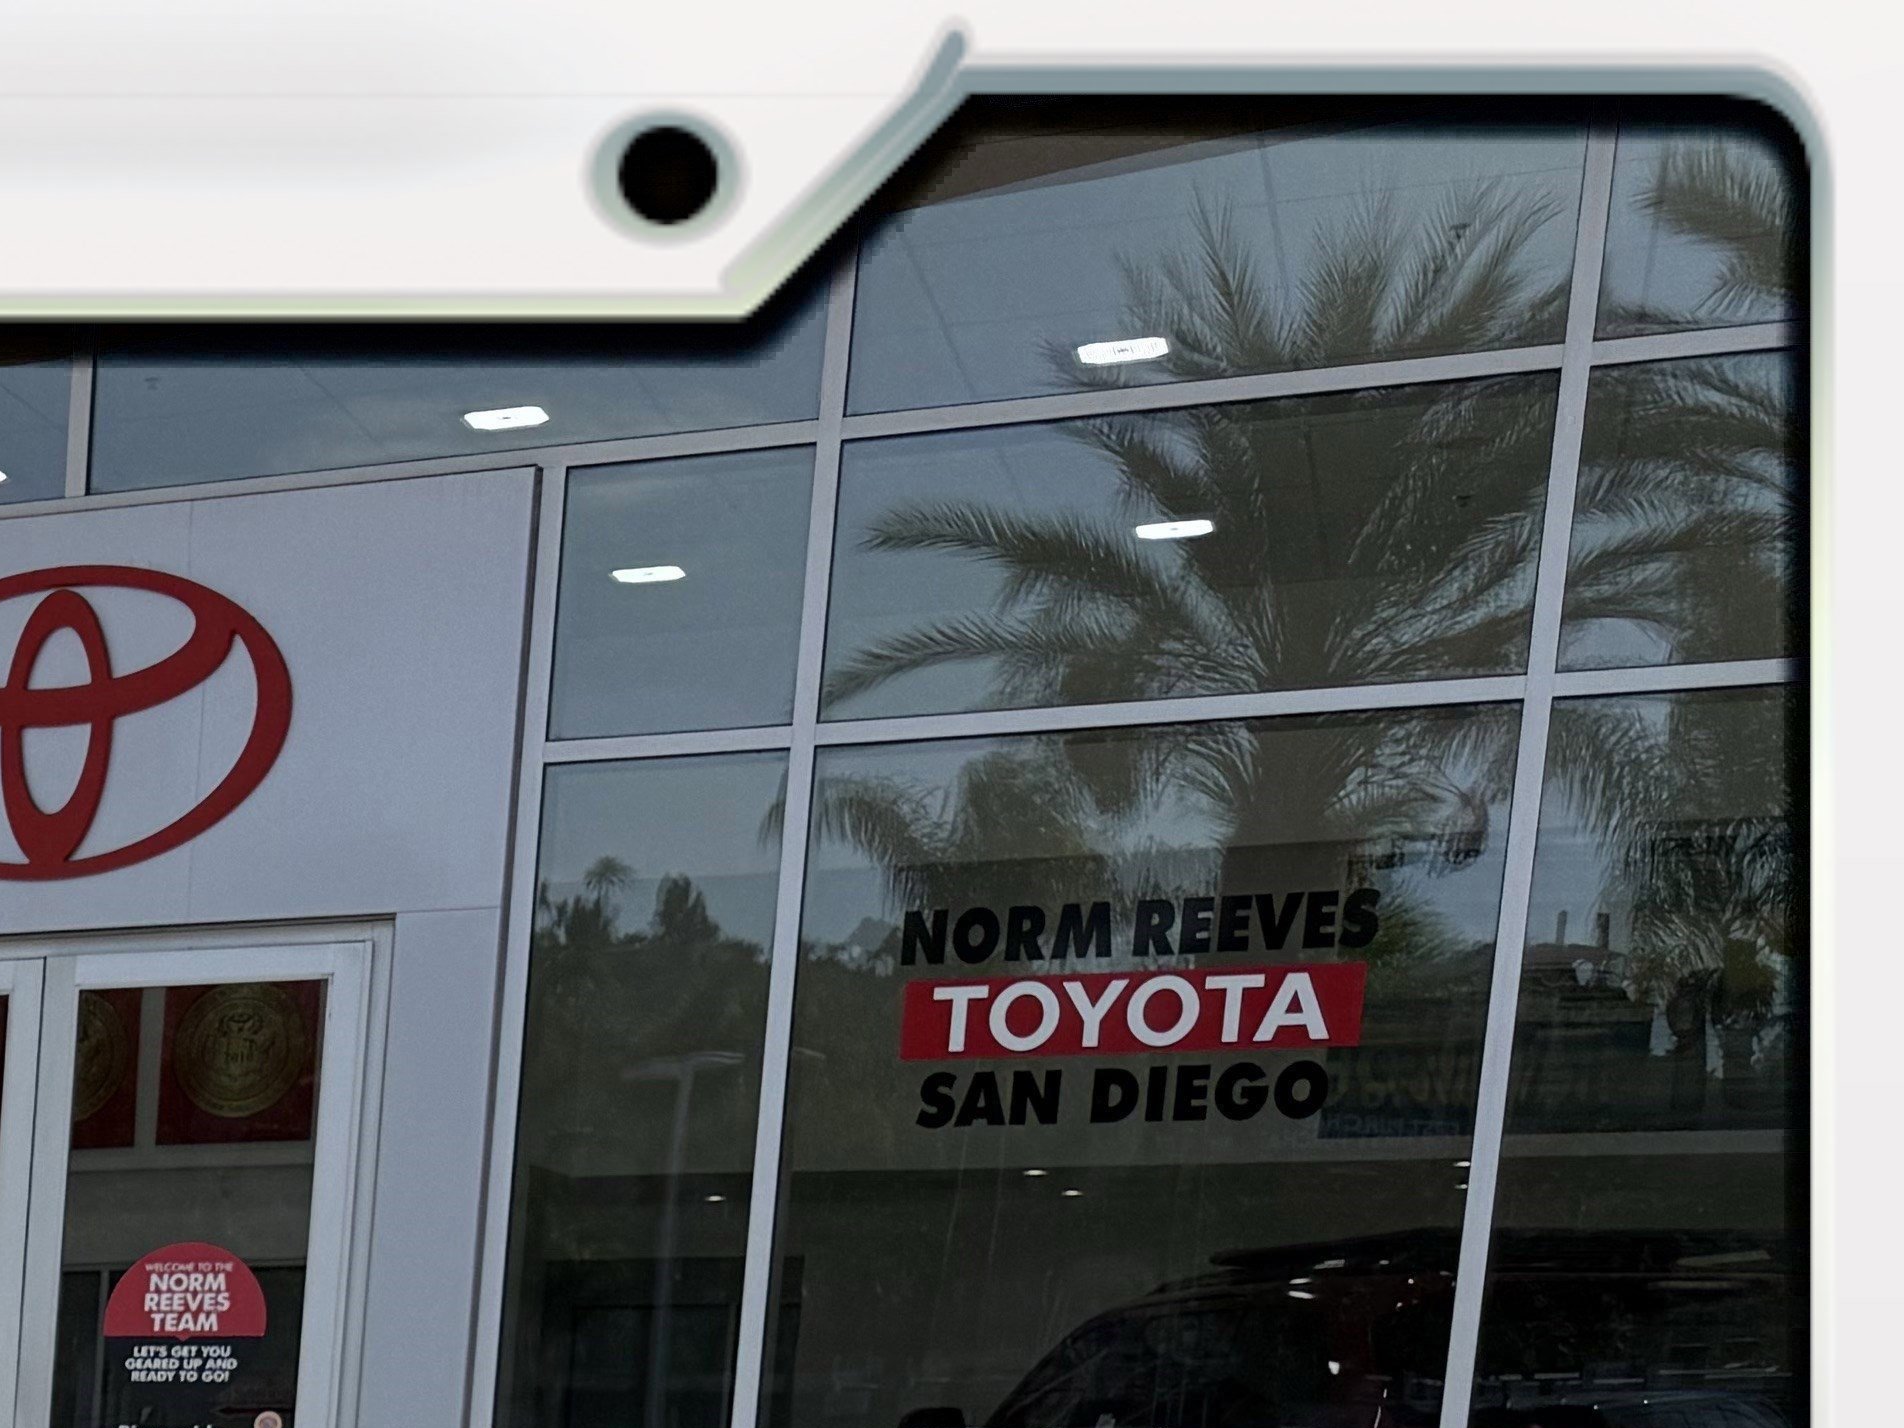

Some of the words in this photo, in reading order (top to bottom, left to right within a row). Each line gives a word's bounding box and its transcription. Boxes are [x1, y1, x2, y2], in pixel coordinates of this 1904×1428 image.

[900, 900, 1113, 966] NORM
[1132, 887, 1381, 957] REEVES
[933, 972, 1330, 1053] TOYOTA
[915, 1069, 1062, 1129] SAN
[1089, 1059, 1329, 1125] DIEGO
[145, 1262, 193, 1272] WELCOME
[198, 1262, 212, 1272] TO
[215, 1262, 234, 1272] THE
[149, 1273, 226, 1291] NORM
[144, 1292, 231, 1312] REEVES
[150, 1313, 218, 1332] TEAM
[133, 1345, 168, 1357] LET'S
[171, 1345, 197, 1357] GET
[201, 1345, 231, 1357] YOU
[125, 1358, 179, 1370] GEARED
[183, 1358, 202, 1370] UP
[205, 1358, 238, 1370] AND
[130, 1370, 175, 1382] READY
[179, 1370, 198, 1382] TO
[201, 1370, 230, 1383] GO!
